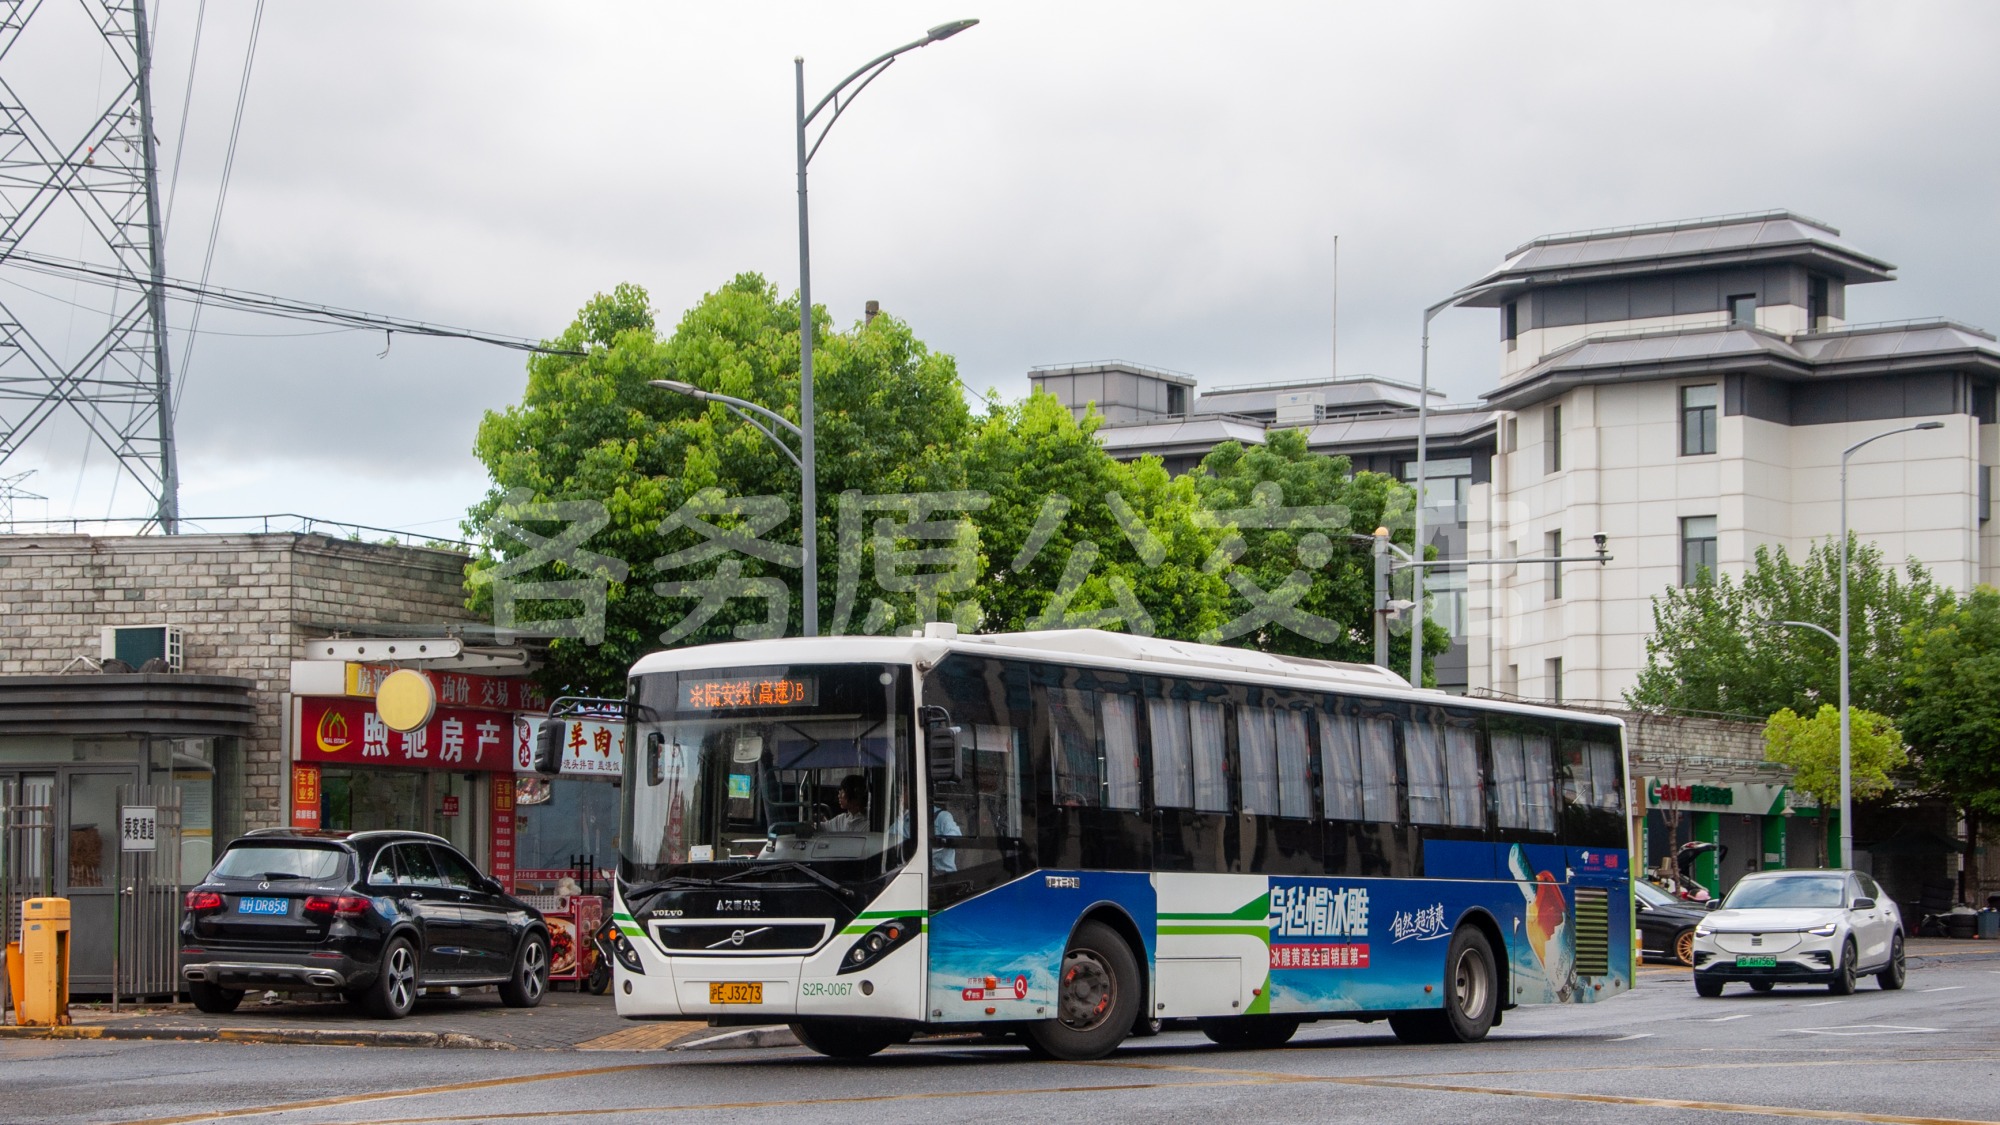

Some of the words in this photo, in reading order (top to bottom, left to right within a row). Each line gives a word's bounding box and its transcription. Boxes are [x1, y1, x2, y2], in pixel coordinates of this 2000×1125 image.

[441, 675, 471, 703] 询价
[481, 679, 509, 706] 交易
[561, 759, 595, 771] 浇头拌面
[124, 817, 154, 840] 乘客通道
[652, 909, 684, 917] VOLVO
[725, 899, 761, 911] 久事公交
[1269, 885, 1370, 937] 乌毡帽冰雕
[1388, 902, 1449, 938] 自然超清爽
[1271, 946, 1369, 967] 冰雕黄酒全国销量第一
[802, 981, 854, 997] S2R-0067
